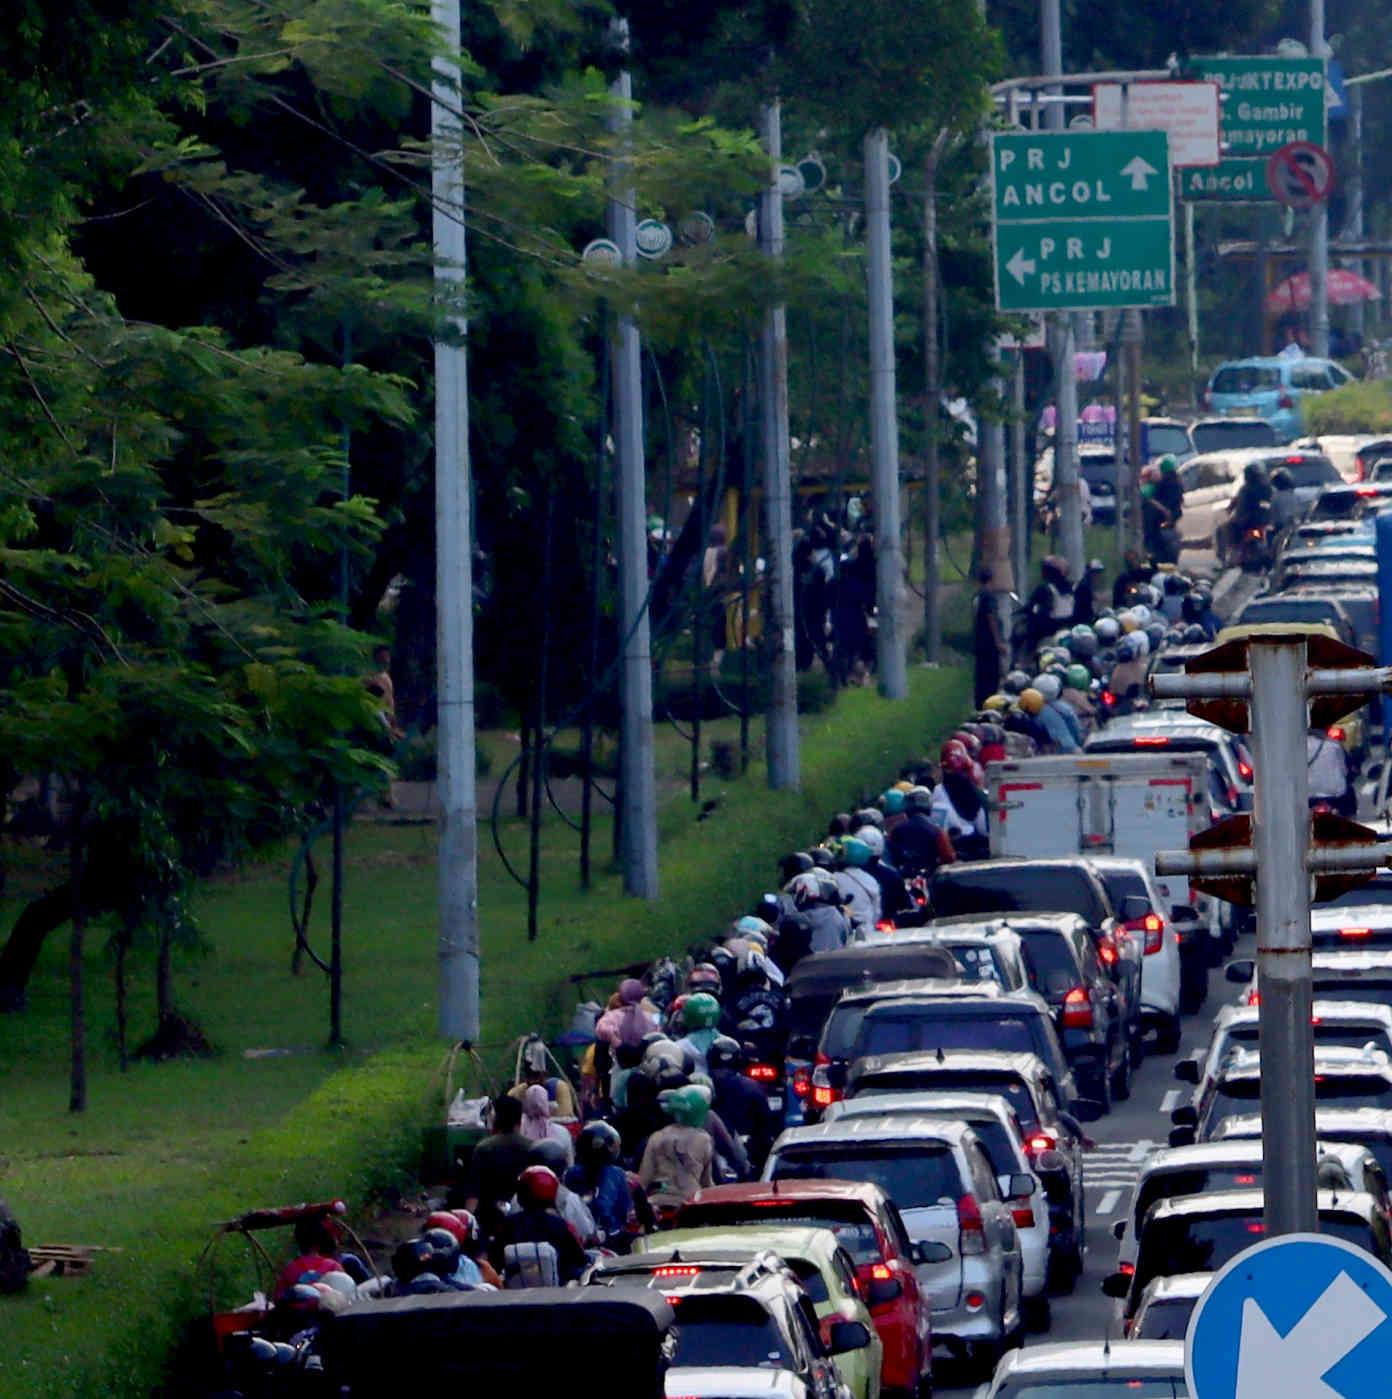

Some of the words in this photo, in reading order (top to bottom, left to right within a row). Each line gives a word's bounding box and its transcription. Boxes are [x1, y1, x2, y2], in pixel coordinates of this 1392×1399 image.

[1238, 103, 1304, 122] Gambir
[1190, 172, 1254, 191] Ancol
[1003, 180, 1112, 206] ANCOL
